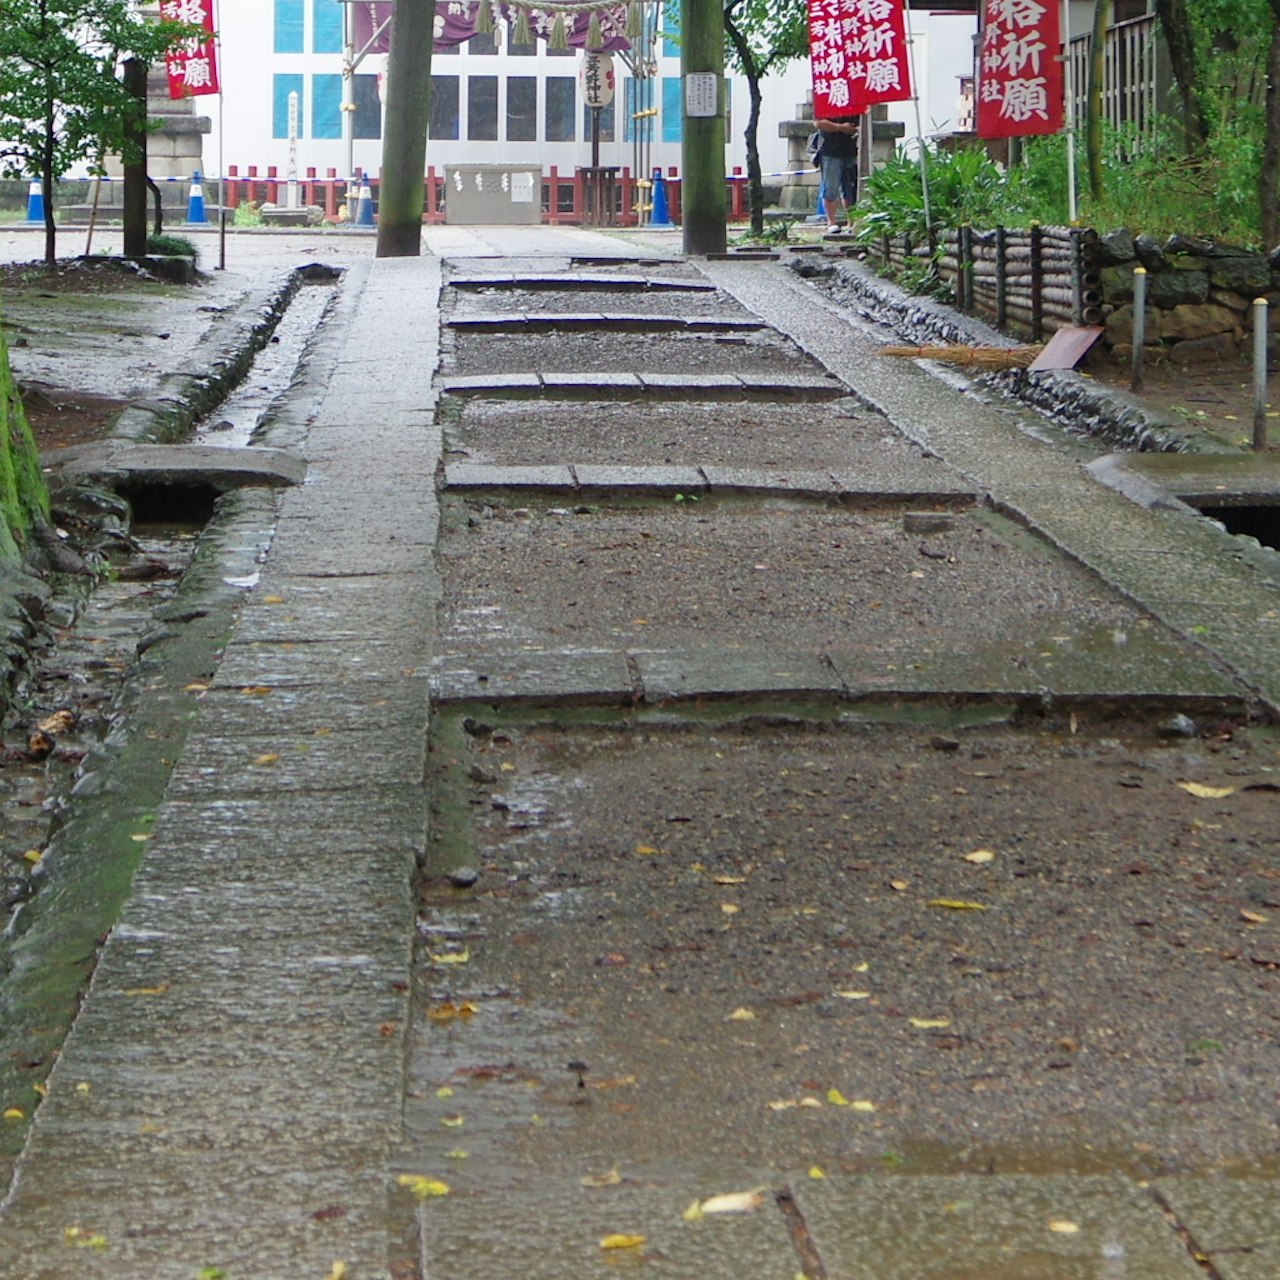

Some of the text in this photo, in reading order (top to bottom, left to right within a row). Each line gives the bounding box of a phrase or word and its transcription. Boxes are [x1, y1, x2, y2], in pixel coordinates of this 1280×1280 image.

[808, 1, 830, 95] 三芳野神社
